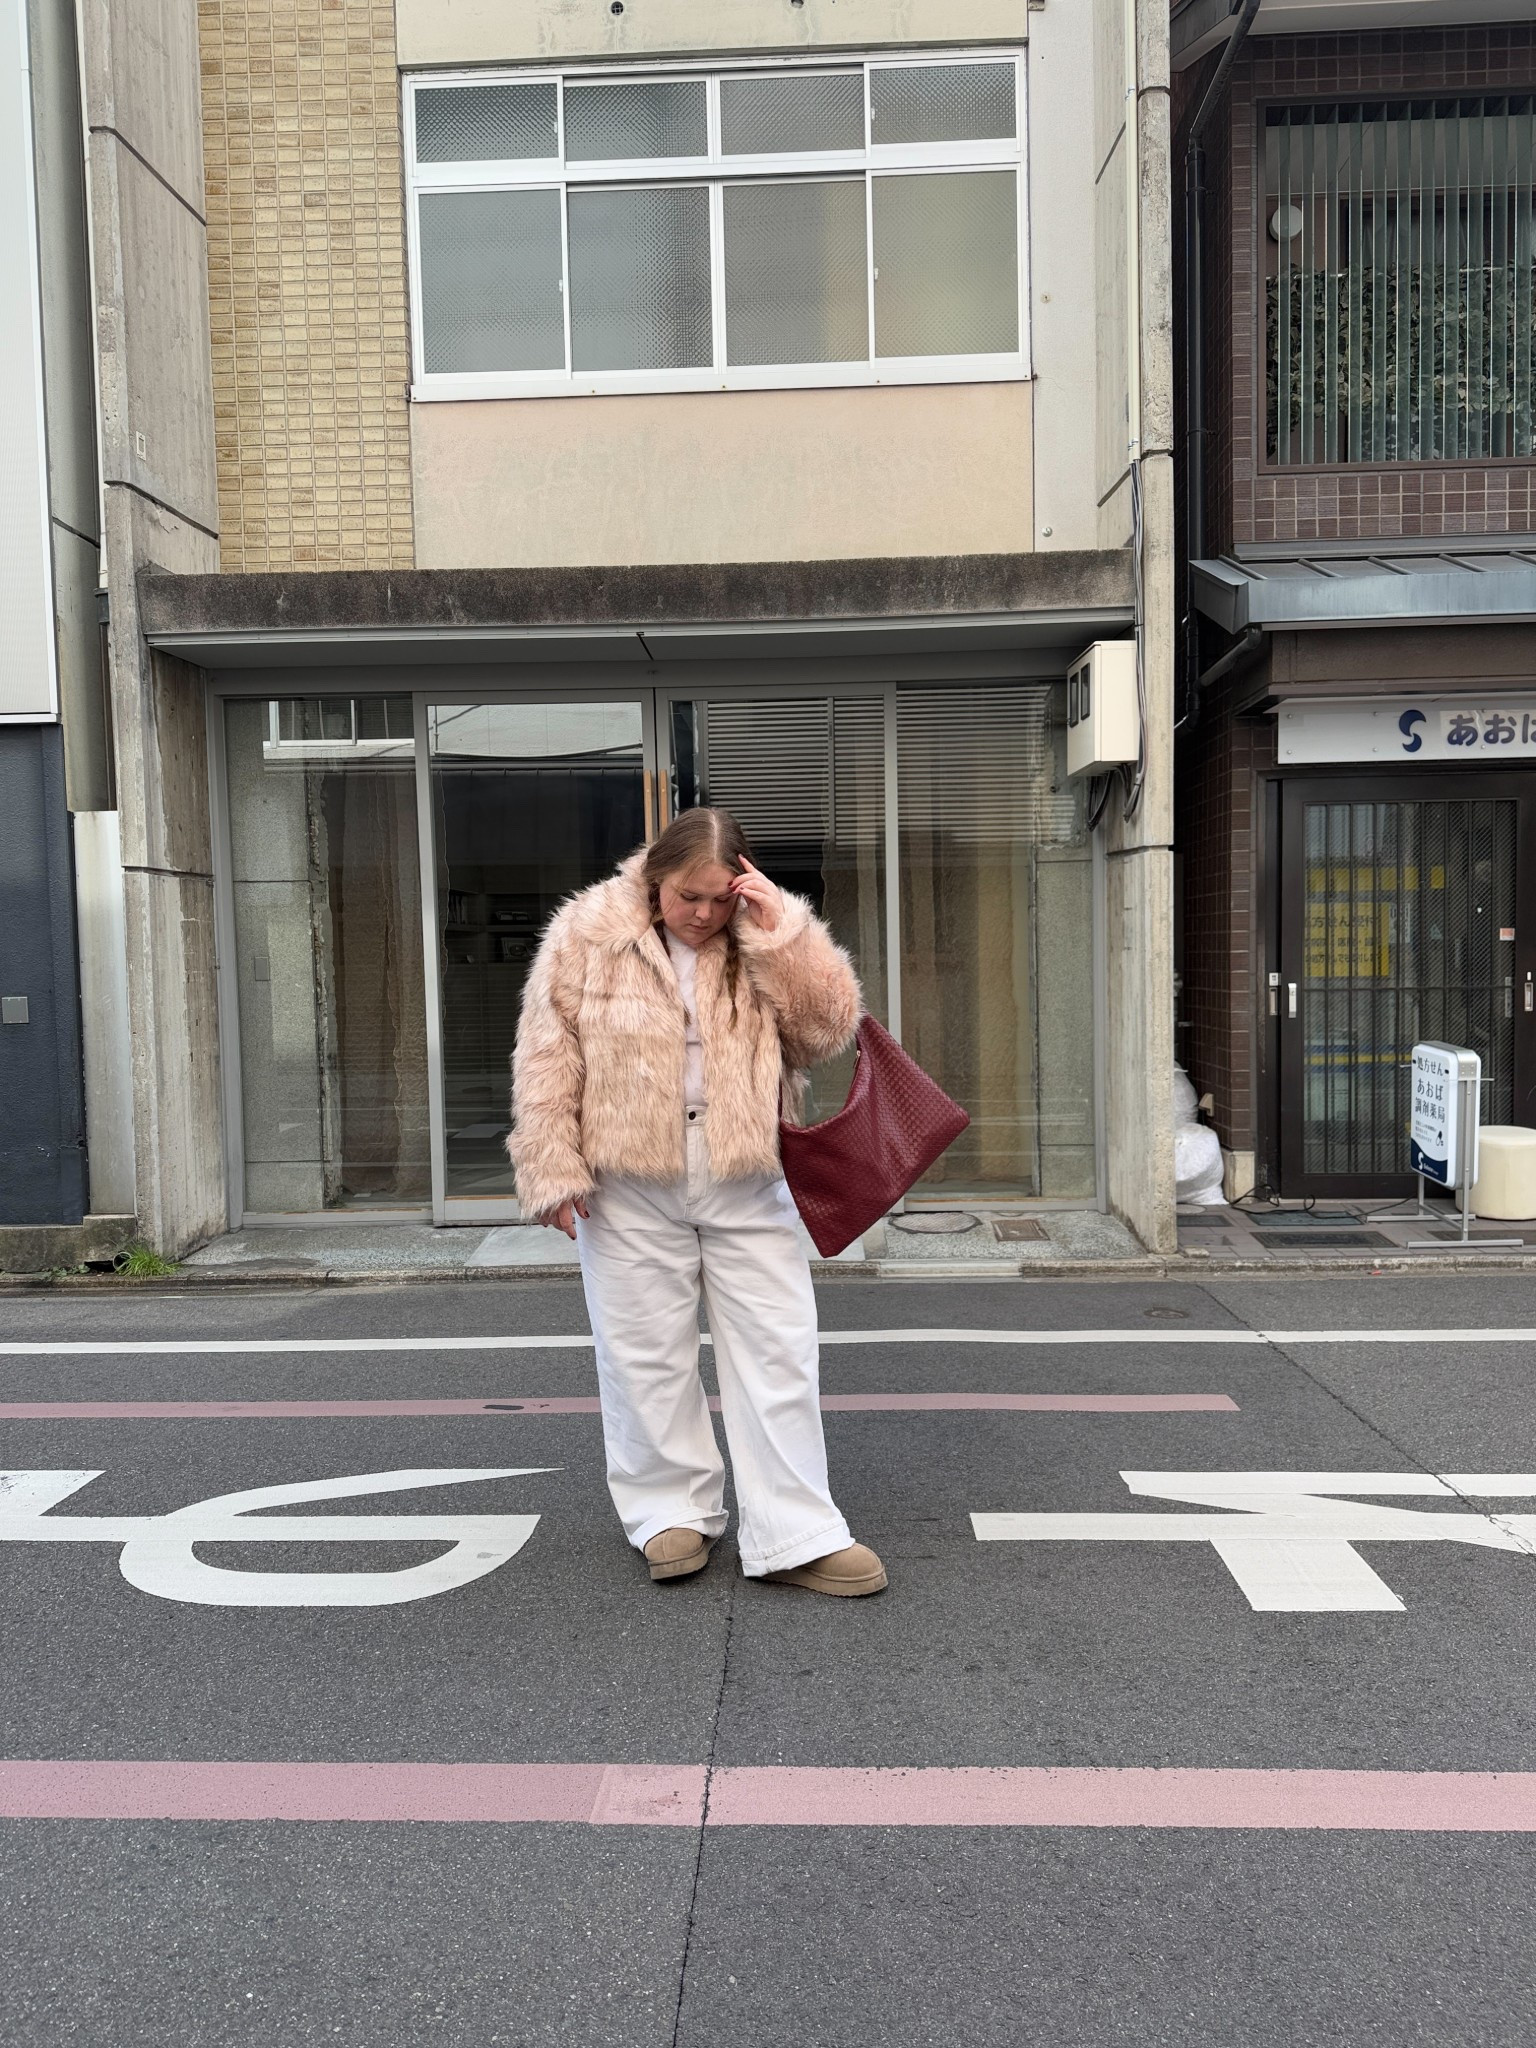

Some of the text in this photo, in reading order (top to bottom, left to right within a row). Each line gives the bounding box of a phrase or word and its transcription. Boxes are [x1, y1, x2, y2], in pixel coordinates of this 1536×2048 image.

[1417, 1056, 1443, 1076] 処方せん
[1417, 1079, 1444, 1100] あおば
[1415, 1098, 1445, 1123] 調剤薬局
